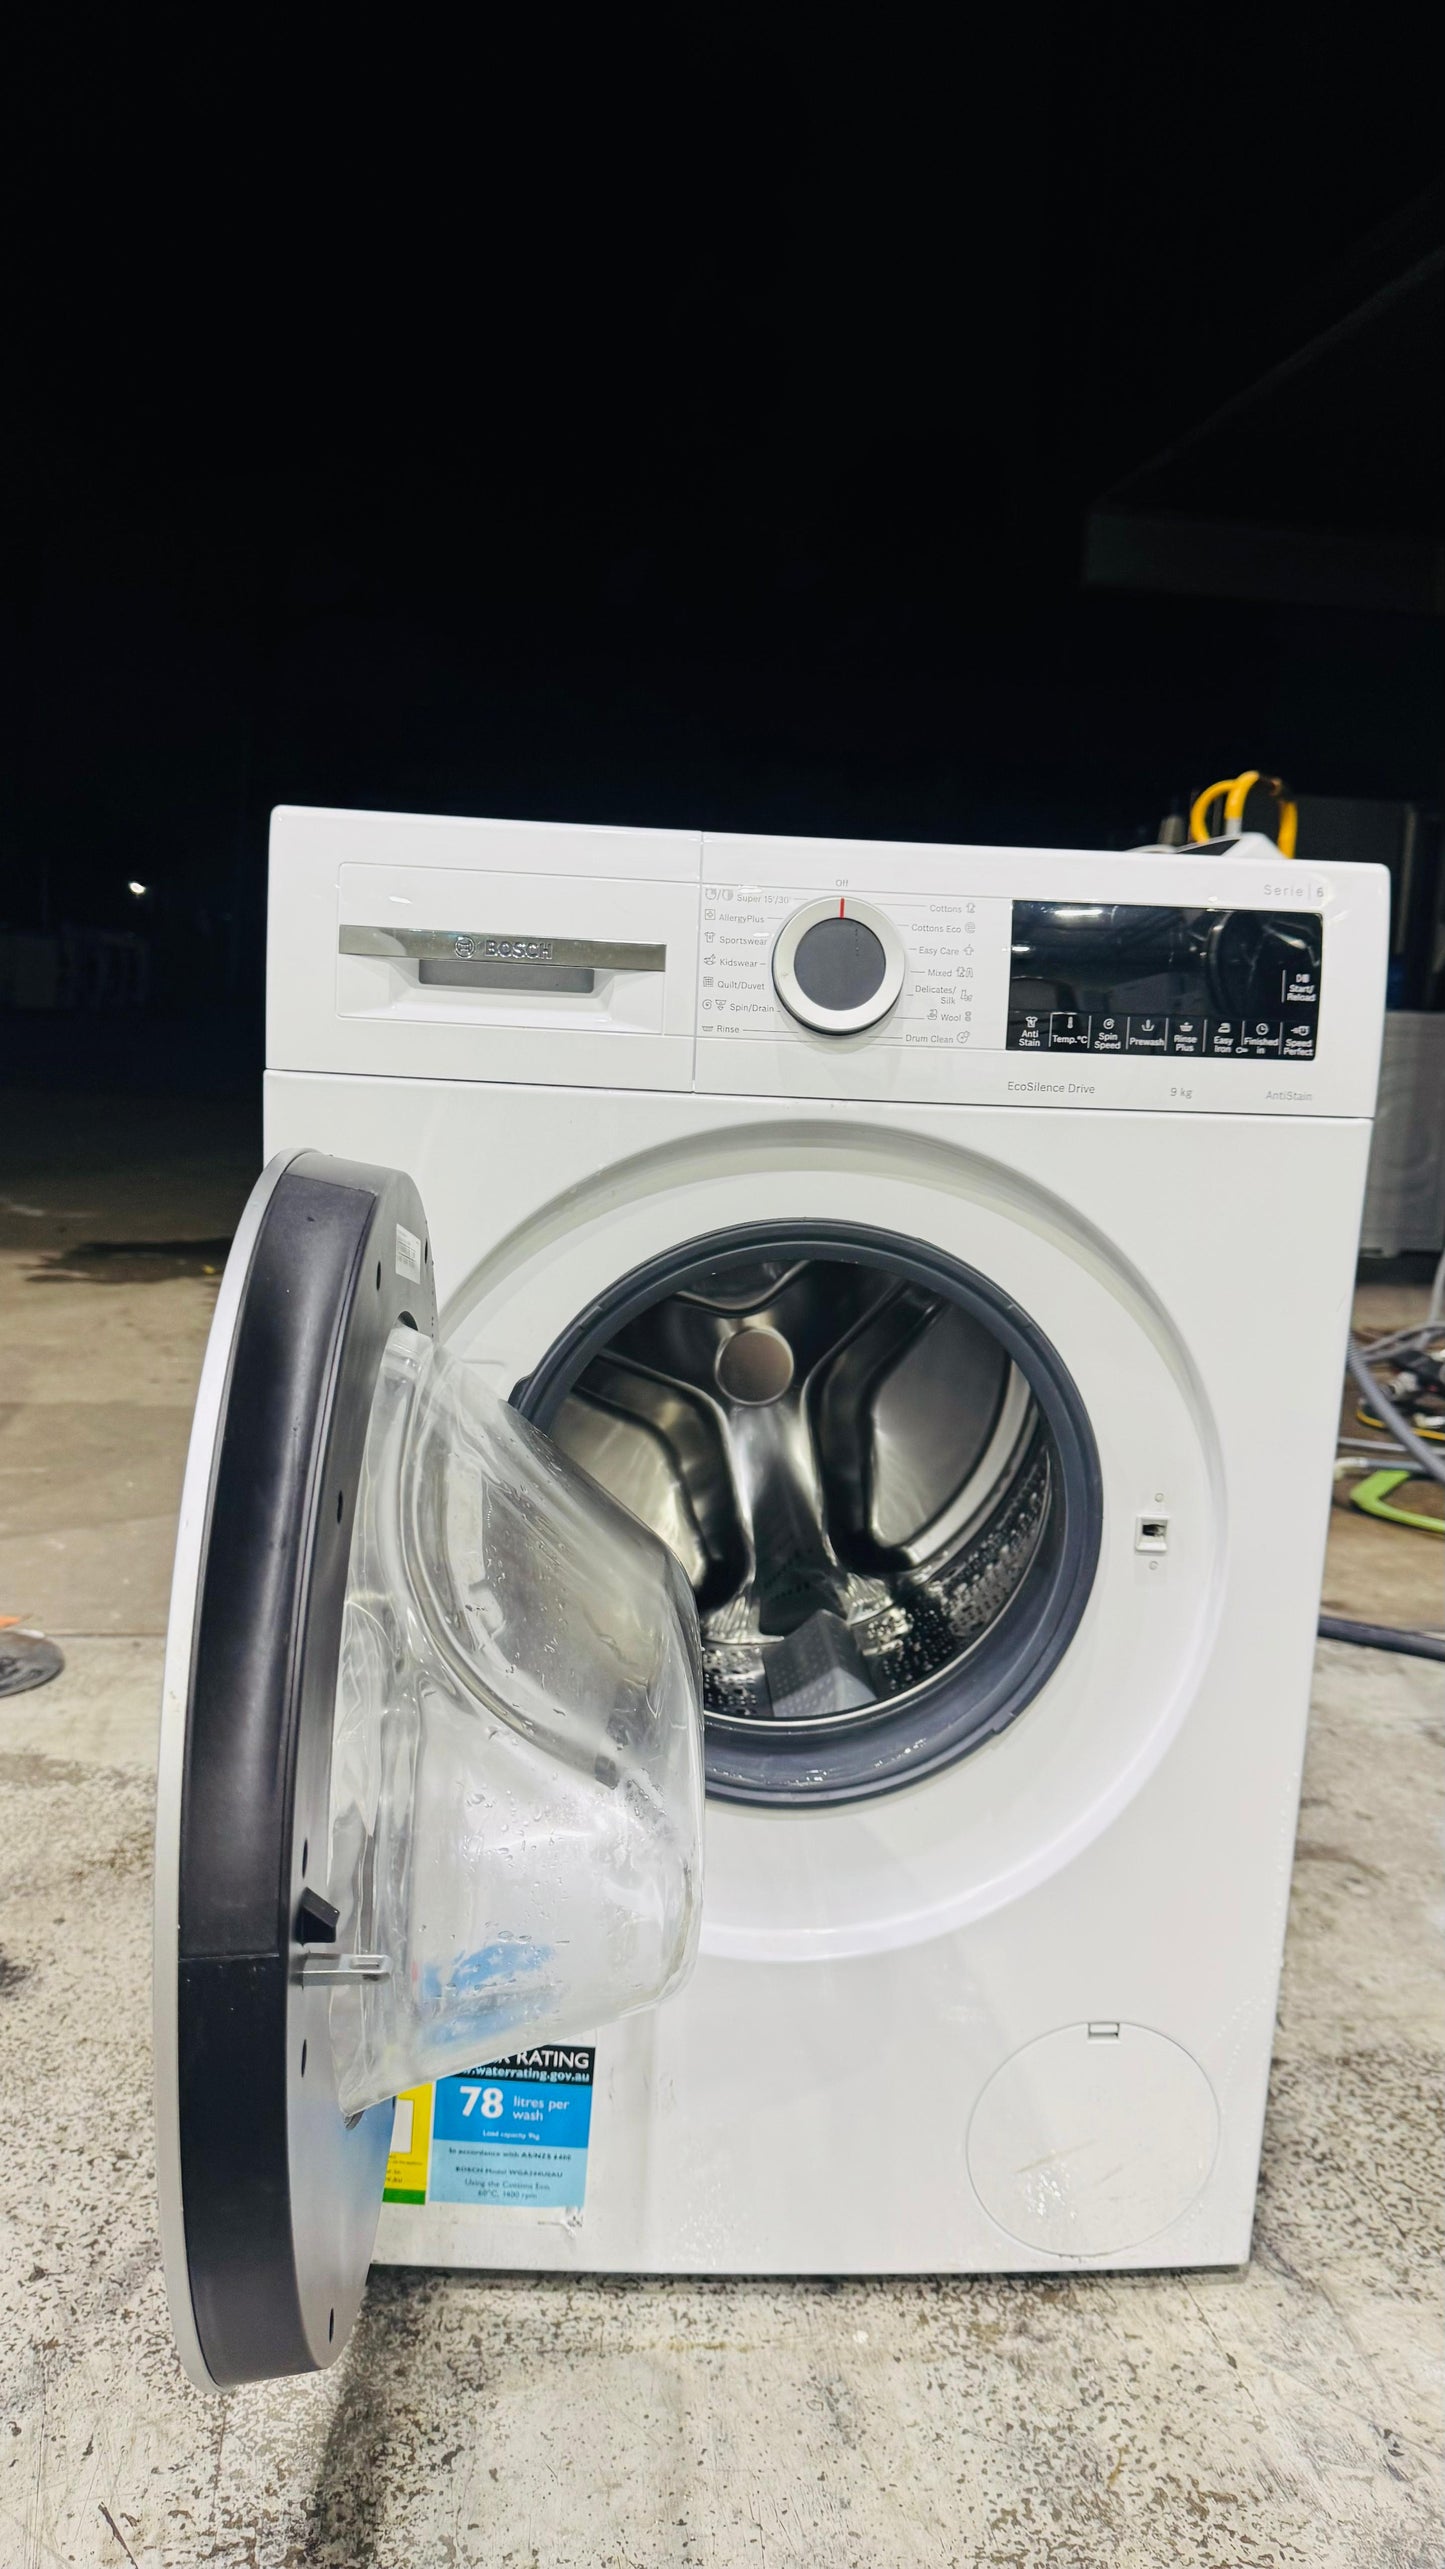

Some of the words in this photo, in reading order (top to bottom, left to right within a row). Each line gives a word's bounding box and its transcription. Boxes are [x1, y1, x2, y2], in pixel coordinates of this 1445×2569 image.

[835, 880, 848, 888] Off
[1264, 884, 1304, 896] Serie
[1316, 887, 1324, 898] 6
[736, 894, 760, 903] Super
[930, 904, 962, 913] Cottons
[719, 914, 765, 924] AllergyPlus
[912, 924, 944, 932] Cottons
[720, 936, 768, 946] Sportswear
[484, 940, 553, 960] BOSCH
[919, 946, 938, 956] Easy
[940, 947, 960, 956] Care
[720, 958, 758, 968] Kidswear
[928, 968, 952, 977] Mixed
[718, 980, 765, 990] Quilt/Duvet
[915, 985, 956, 994] Delicates/
[940, 996, 956, 1004] Silk
[1286, 992, 1316, 1002] Reload
[730, 1003, 774, 1012] Spin/Drain
[716, 1024, 740, 1034] Rinse
[1021, 1030, 1039, 1038] Anti
[906, 1034, 928, 1042] Drum
[930, 1035, 954, 1044] Clean
[1098, 1032, 1118, 1042] Spin
[1130, 1037, 1164, 1046] Prewash
[1174, 1034, 1198, 1044] Rinse
[1214, 1036, 1234, 1046] Easy
[1244, 1037, 1279, 1046] Finished
[1018, 1038, 1040, 1047] Stain
[1094, 1040, 1121, 1050] Speed
[1176, 1043, 1194, 1052] Plus
[1286, 1038, 1312, 1048] Speed
[1214, 1044, 1232, 1053] Iron
[1256, 1046, 1266, 1054] in
[1284, 1047, 1314, 1056] Perfect
[1008, 1081, 1065, 1092] EcoSilence
[1068, 1084, 1095, 1094] Drive
[1170, 1088, 1177, 1096] 9
[1180, 1088, 1192, 1099] kg
[1266, 1090, 1312, 1100] AntiStain
[516, 2050, 590, 2070] RATING
[460, 2086, 504, 2118] 78
[514, 2096, 544, 2109] litres
[548, 2100, 570, 2112] per
[512, 2110, 544, 2122] wash
